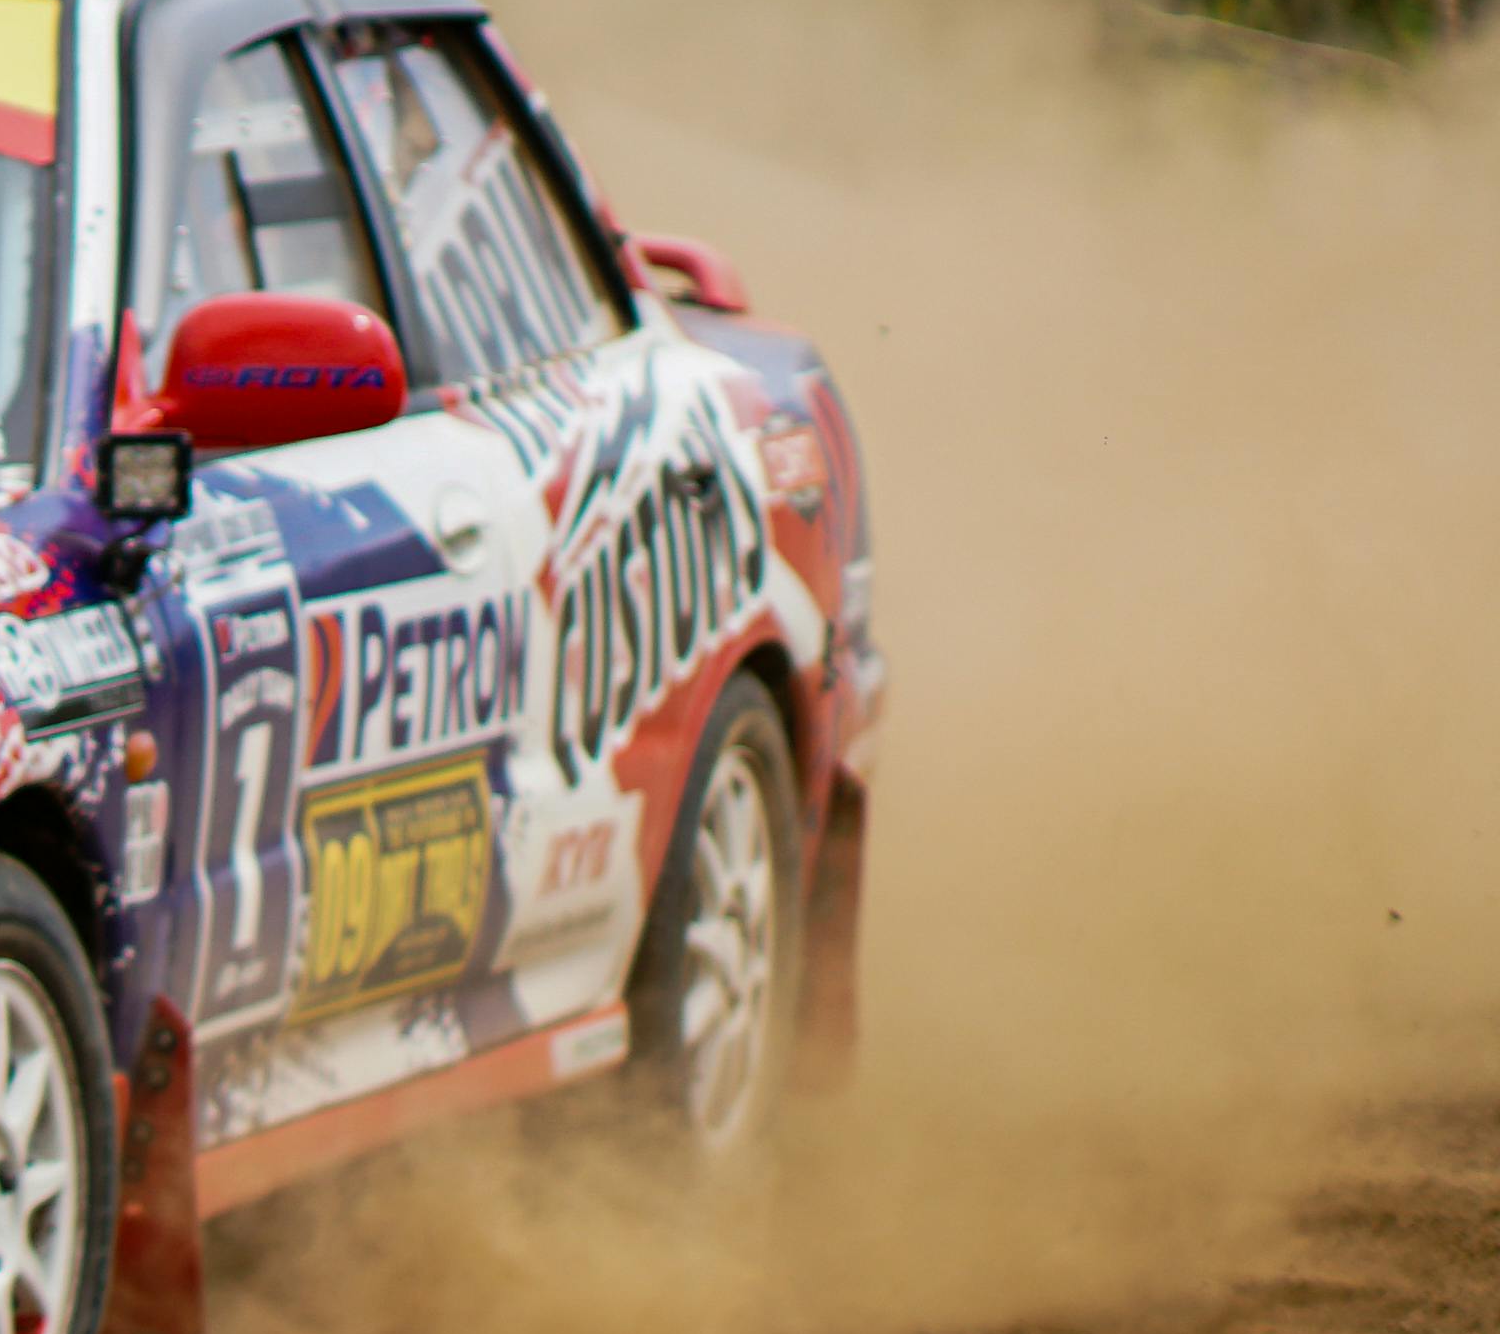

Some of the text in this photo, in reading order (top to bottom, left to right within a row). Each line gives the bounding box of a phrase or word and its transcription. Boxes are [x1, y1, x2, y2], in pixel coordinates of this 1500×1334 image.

[235, 366, 385, 390] ROTA
[353, 591, 530, 761] PETRON
[551, 387, 768, 789] CUSTOMS
[232, 722, 272, 951] 1
